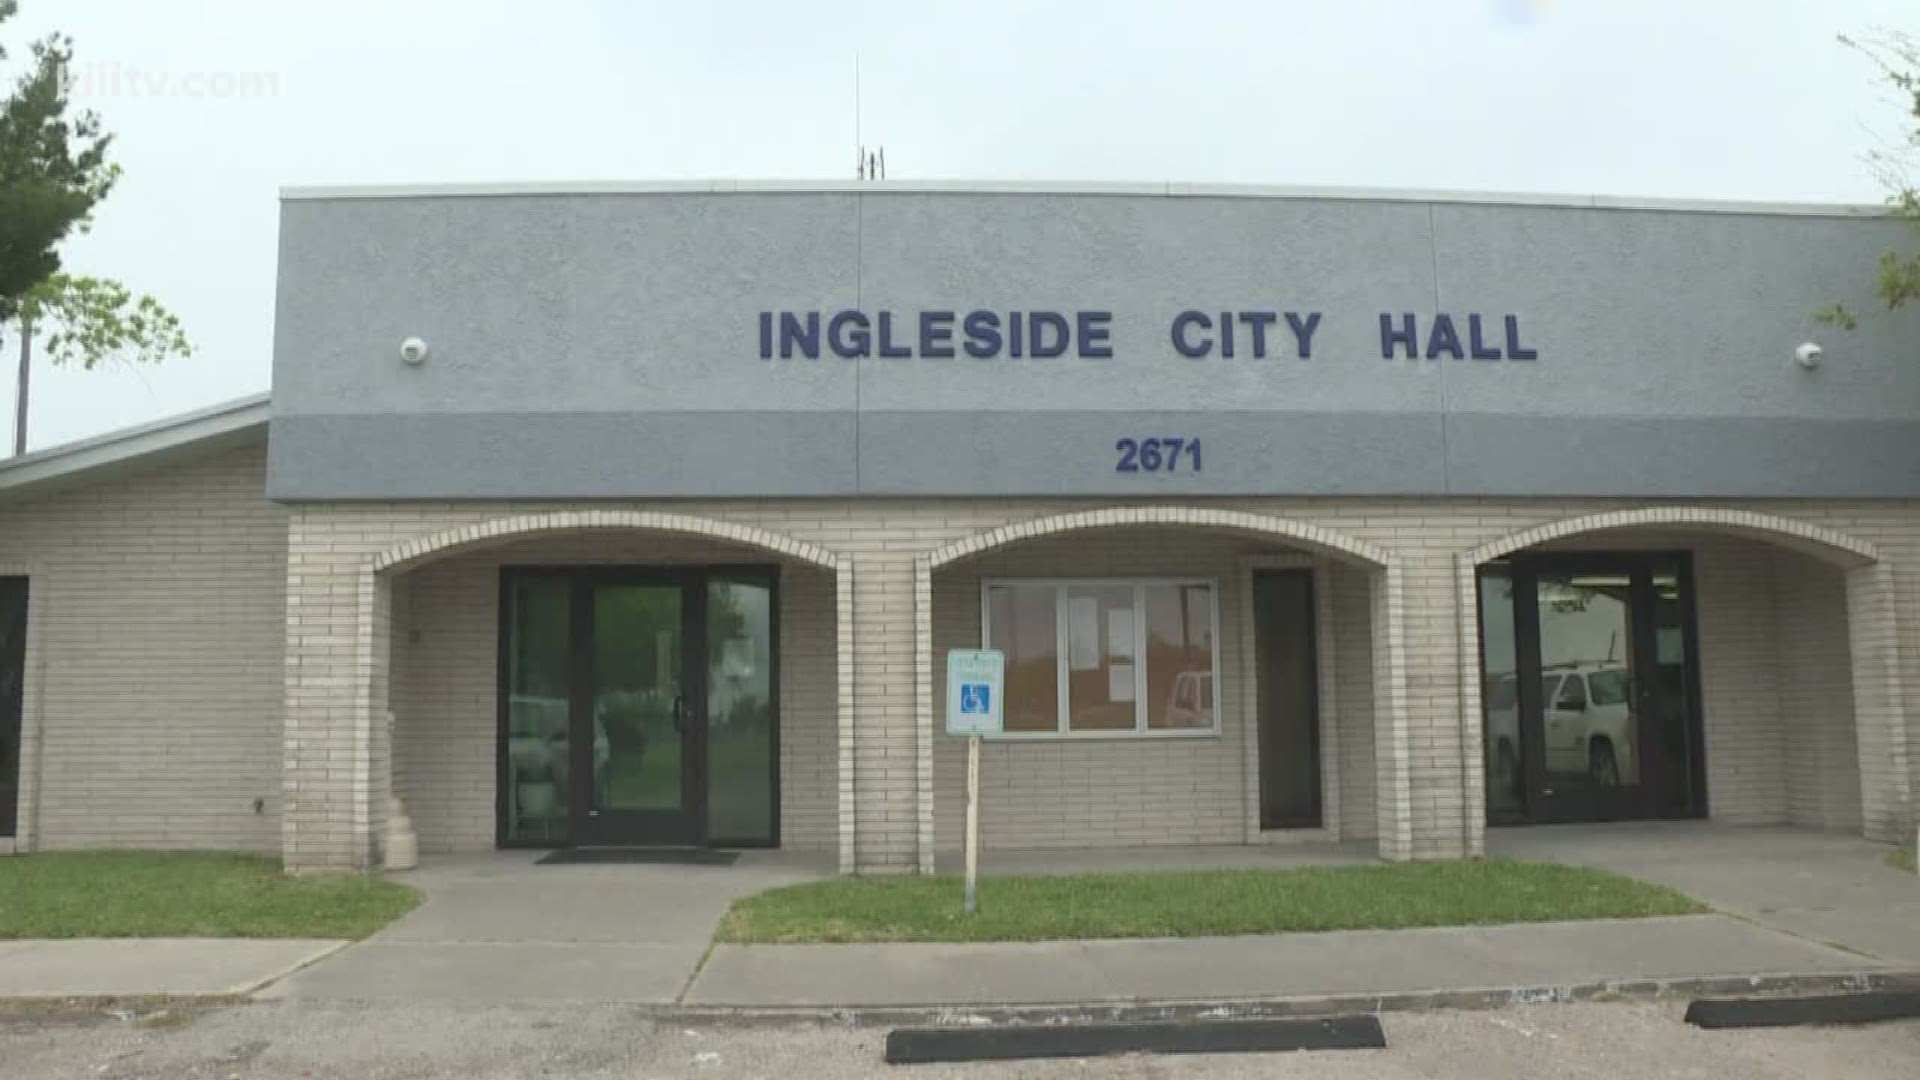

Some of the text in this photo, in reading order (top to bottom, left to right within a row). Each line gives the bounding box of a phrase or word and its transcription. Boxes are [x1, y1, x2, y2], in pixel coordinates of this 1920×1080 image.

[759, 311, 1537, 359] INGLESIDE CITY HALL
[1115, 437, 1202, 472] 2671
